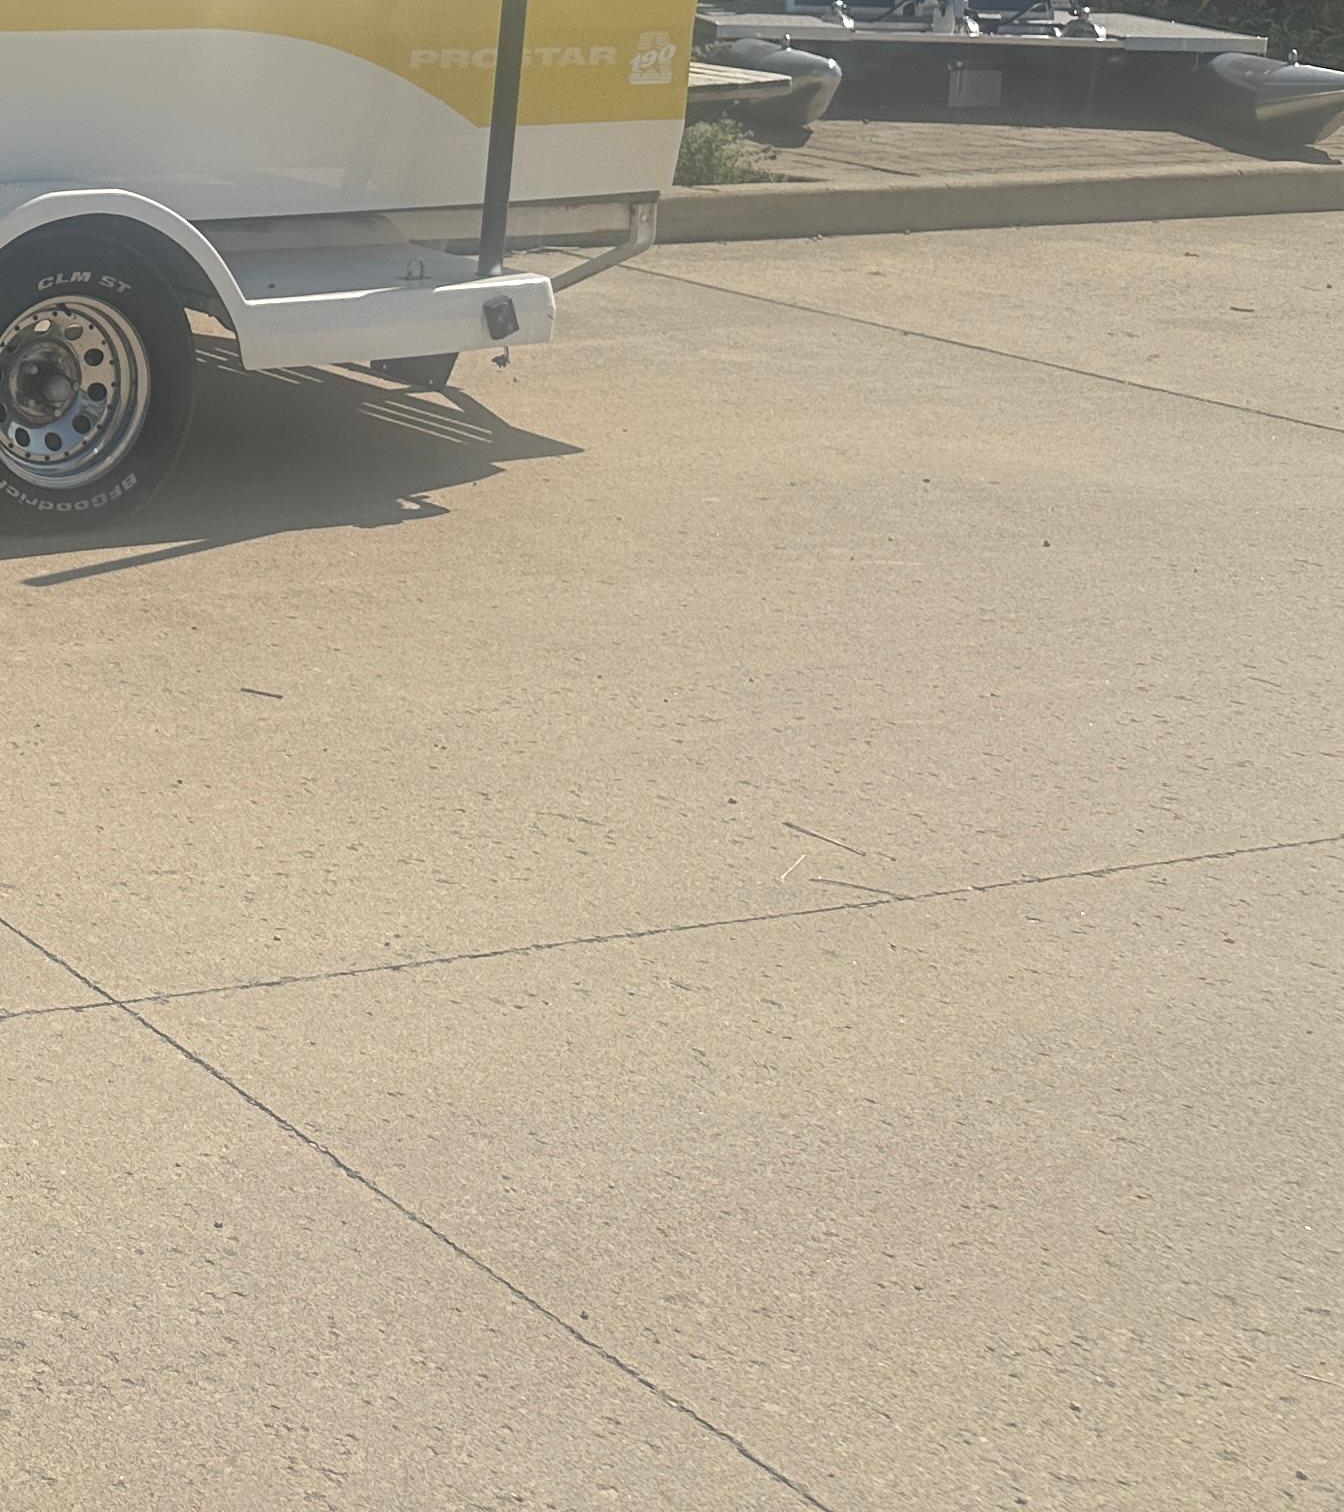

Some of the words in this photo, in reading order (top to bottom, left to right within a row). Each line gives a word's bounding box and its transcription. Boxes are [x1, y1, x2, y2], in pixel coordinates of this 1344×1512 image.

[630, 44, 676, 71] 190
[37, 271, 92, 291] CLM
[98, 275, 134, 293] ST
